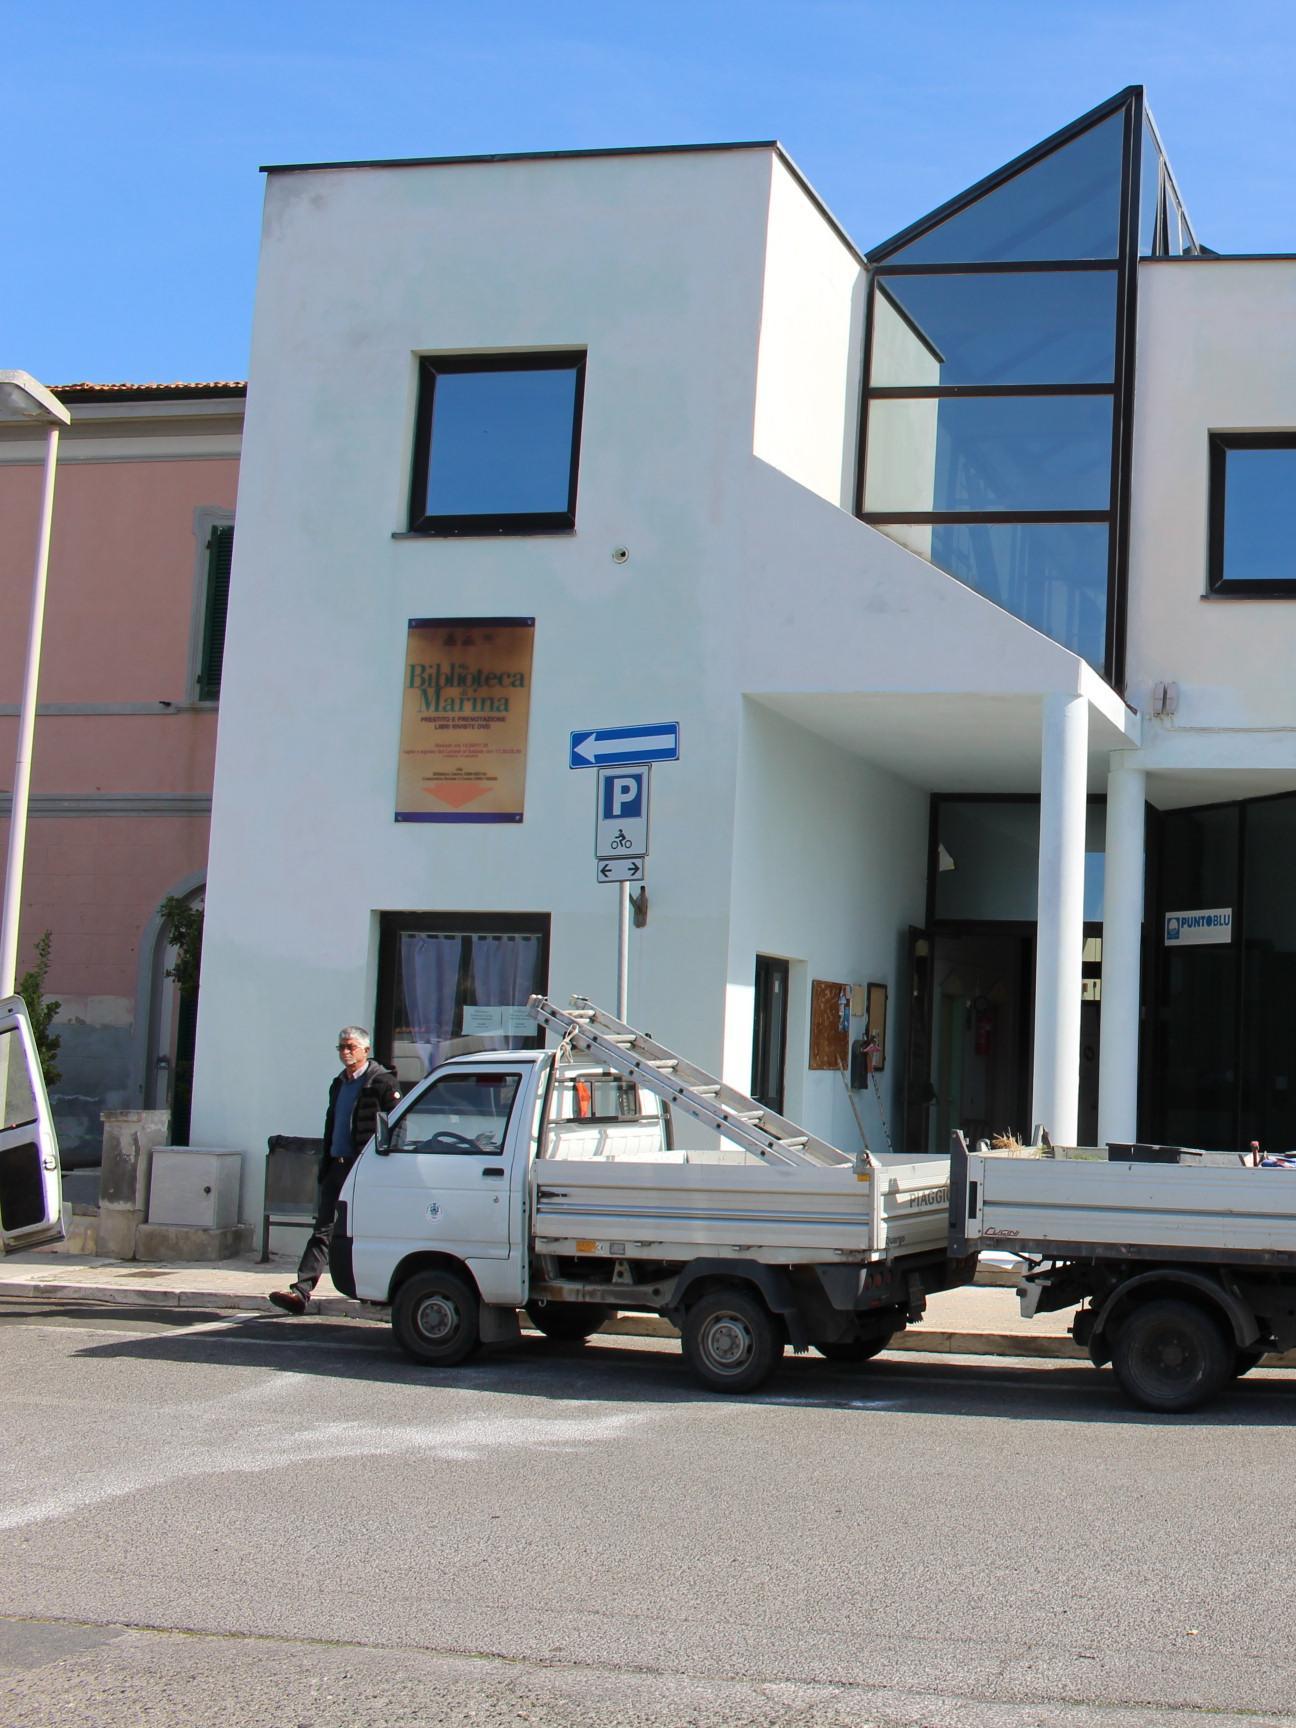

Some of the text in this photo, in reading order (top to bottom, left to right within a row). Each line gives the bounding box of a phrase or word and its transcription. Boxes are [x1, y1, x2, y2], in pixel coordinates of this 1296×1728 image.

[408, 663, 526, 689] Biblioteca
[417, 687, 510, 713] Marina
[612, 777, 638, 816] P
[1180, 914, 1230, 929] PUNTOBLU
